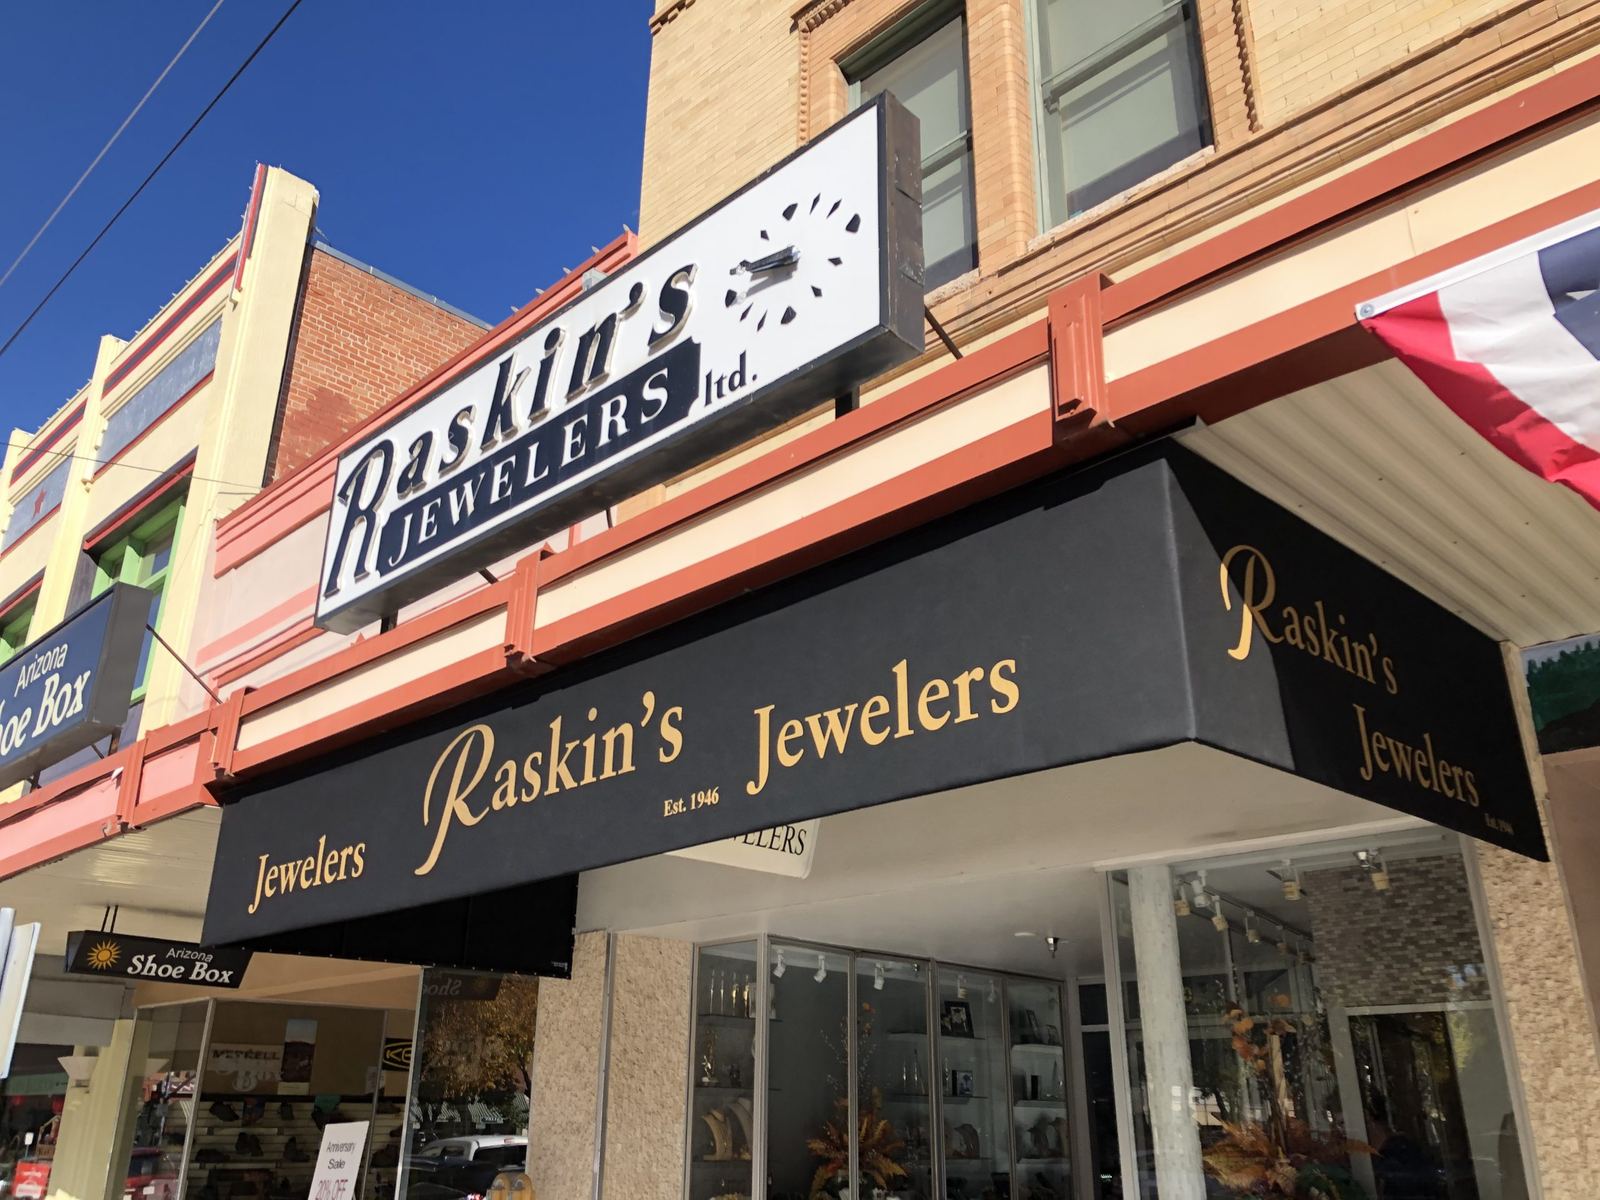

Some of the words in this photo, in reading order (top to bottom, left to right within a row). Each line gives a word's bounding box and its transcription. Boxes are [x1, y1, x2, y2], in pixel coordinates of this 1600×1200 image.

[703, 352, 758, 408] ltd.
[324, 263, 700, 598] Raskin's
[388, 366, 671, 568] JEWELERS
[1220, 544, 1398, 694] Raskin's
[14, 643, 68, 698] Arizona
[0, 699, 32, 756] oe
[31, 670, 91, 738] Box
[247, 834, 366, 914] Jewelers
[414, 690, 684, 876] Raskin's
[746, 658, 1021, 795] Jewelers
[1352, 703, 1480, 807] Jewelers
[663, 798, 687, 817] Est.
[690, 786, 720, 810] 1946
[127, 954, 185, 979] Shoe
[188, 961, 234, 983] Box
[166, 947, 213, 963] Arizona
[327, 1158, 346, 1170] Sale
